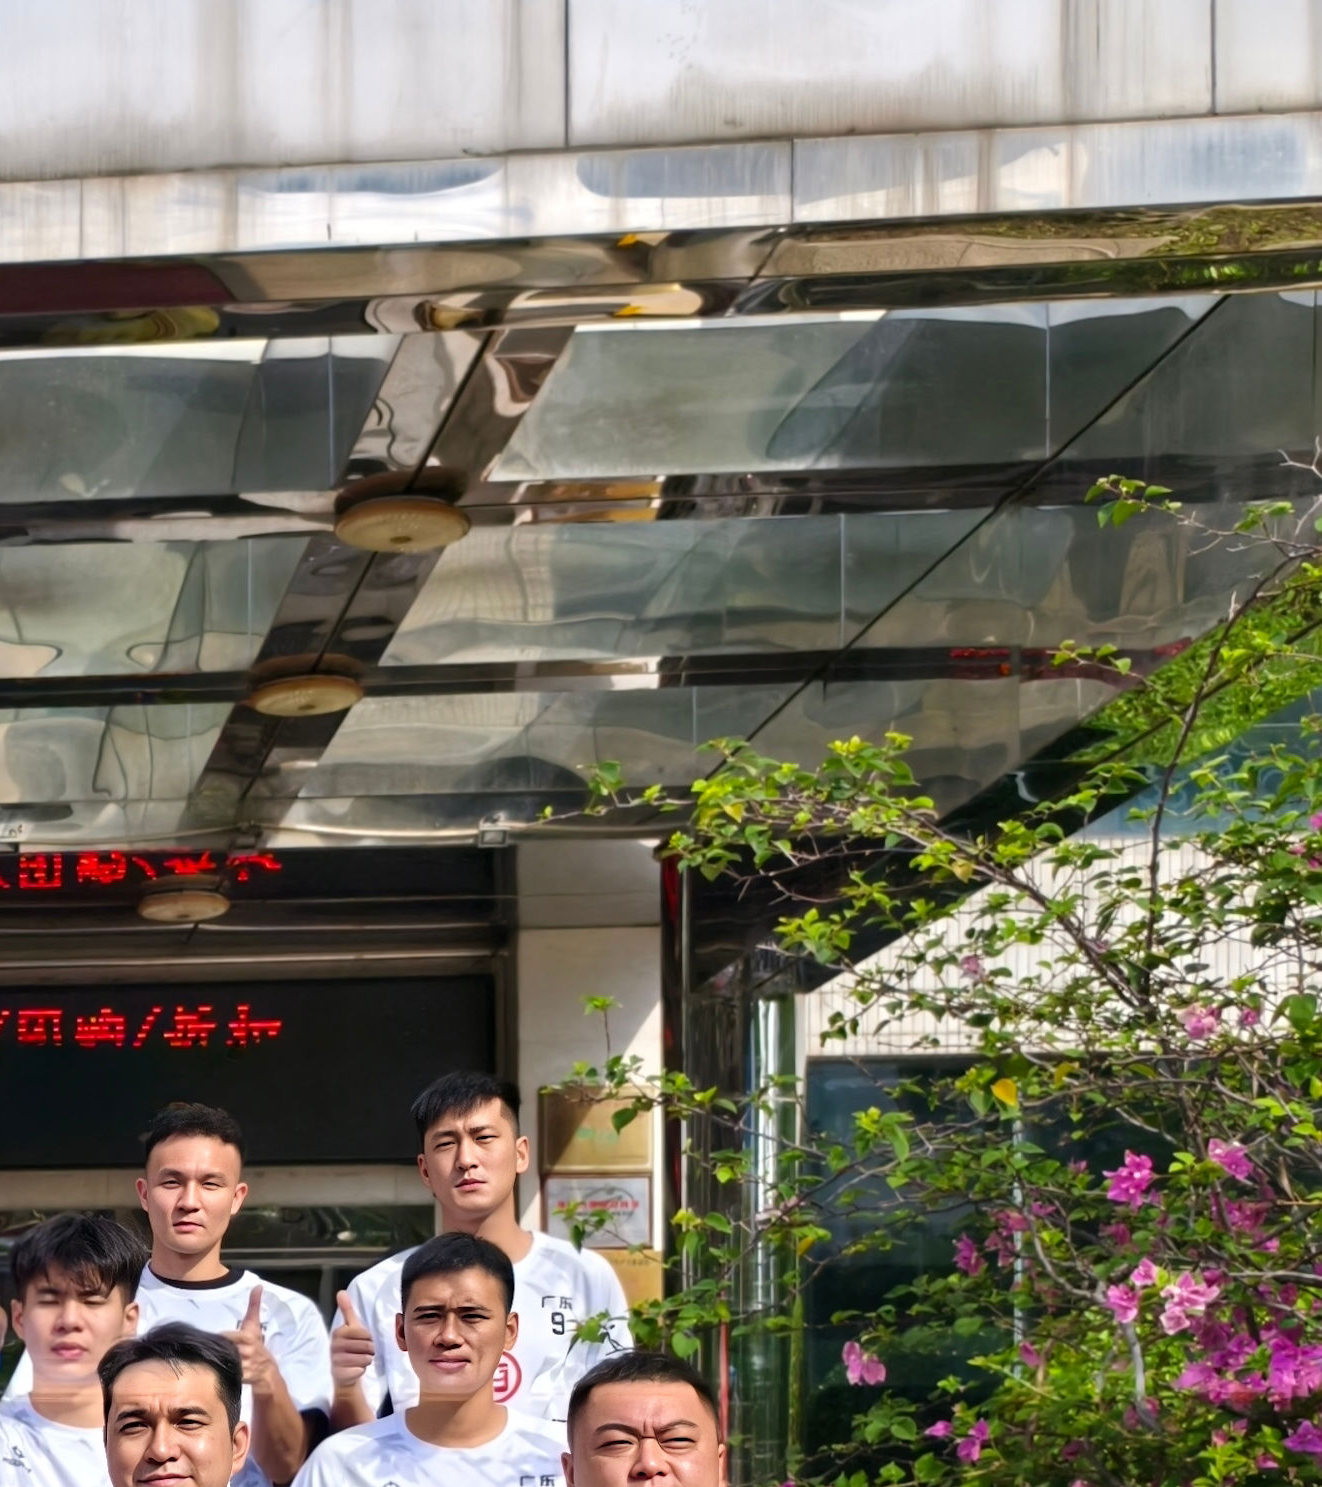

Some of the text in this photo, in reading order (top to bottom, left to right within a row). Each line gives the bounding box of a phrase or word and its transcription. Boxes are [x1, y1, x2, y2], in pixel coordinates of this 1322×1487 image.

[541, 1295, 573, 1310] 广东
[551, 1312, 565, 1335] 9
[520, 1474, 555, 1487] 广东
